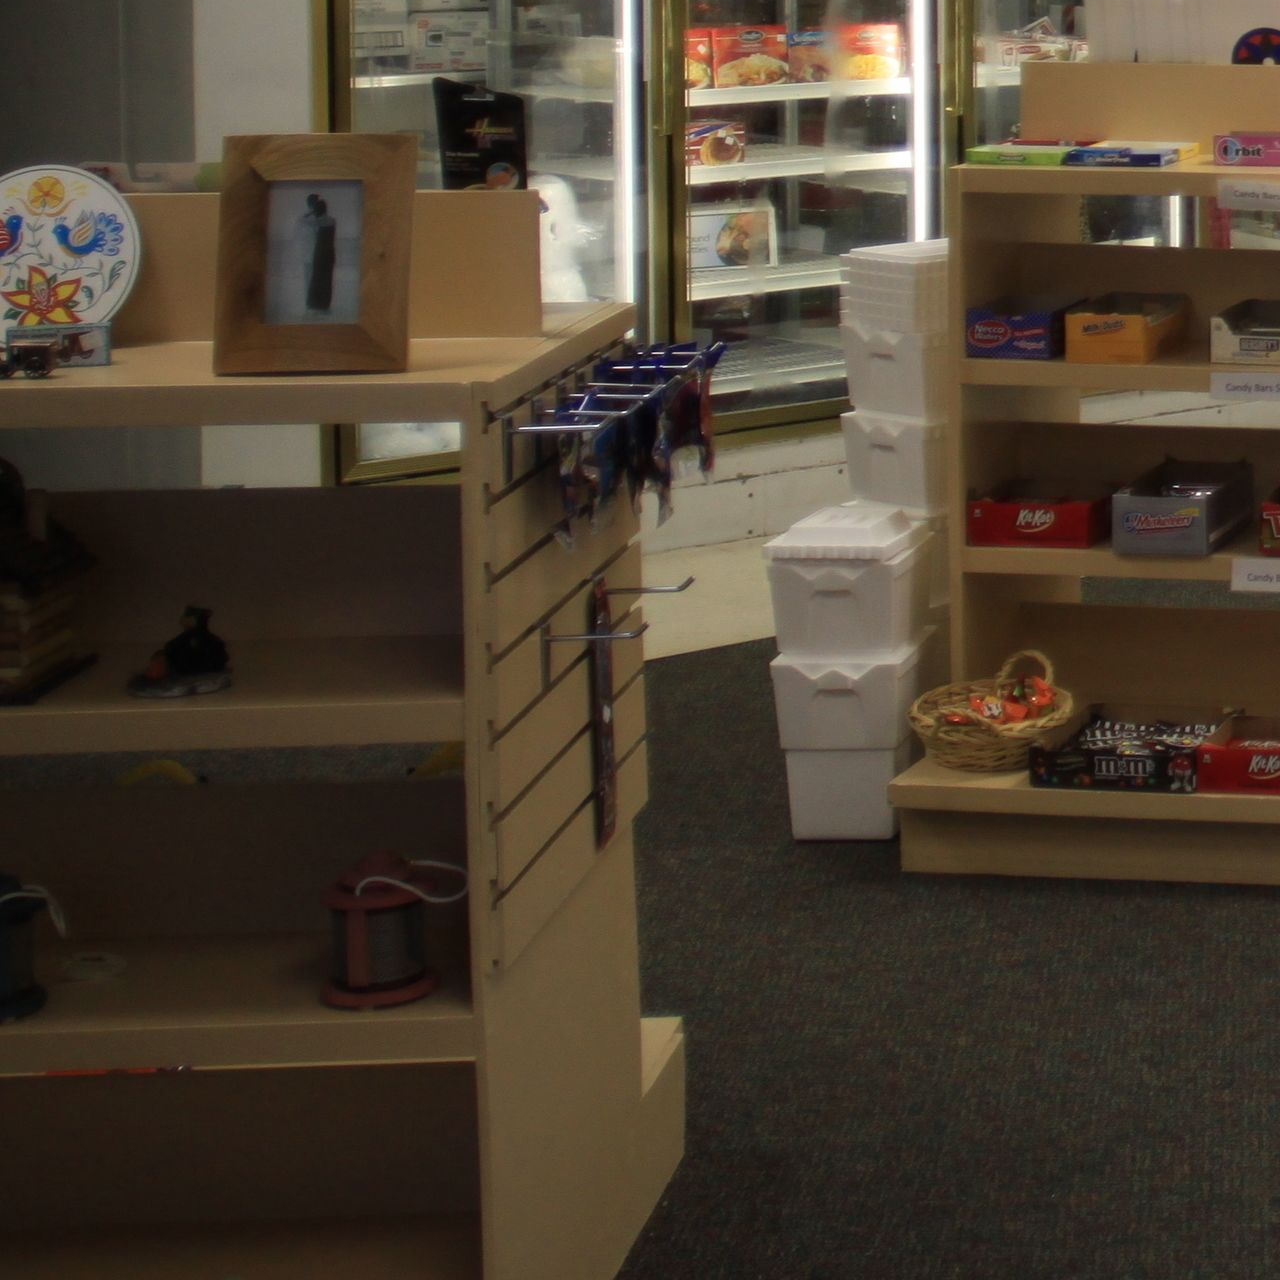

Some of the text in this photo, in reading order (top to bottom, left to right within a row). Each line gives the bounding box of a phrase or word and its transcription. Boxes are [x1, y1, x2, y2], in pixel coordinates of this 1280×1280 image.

[1218, 139, 1262, 162] Orbit
[1225, 383, 1252, 394] Candy
[1254, 384, 1273, 392] Bars
[1247, 573, 1274, 585] Candy
